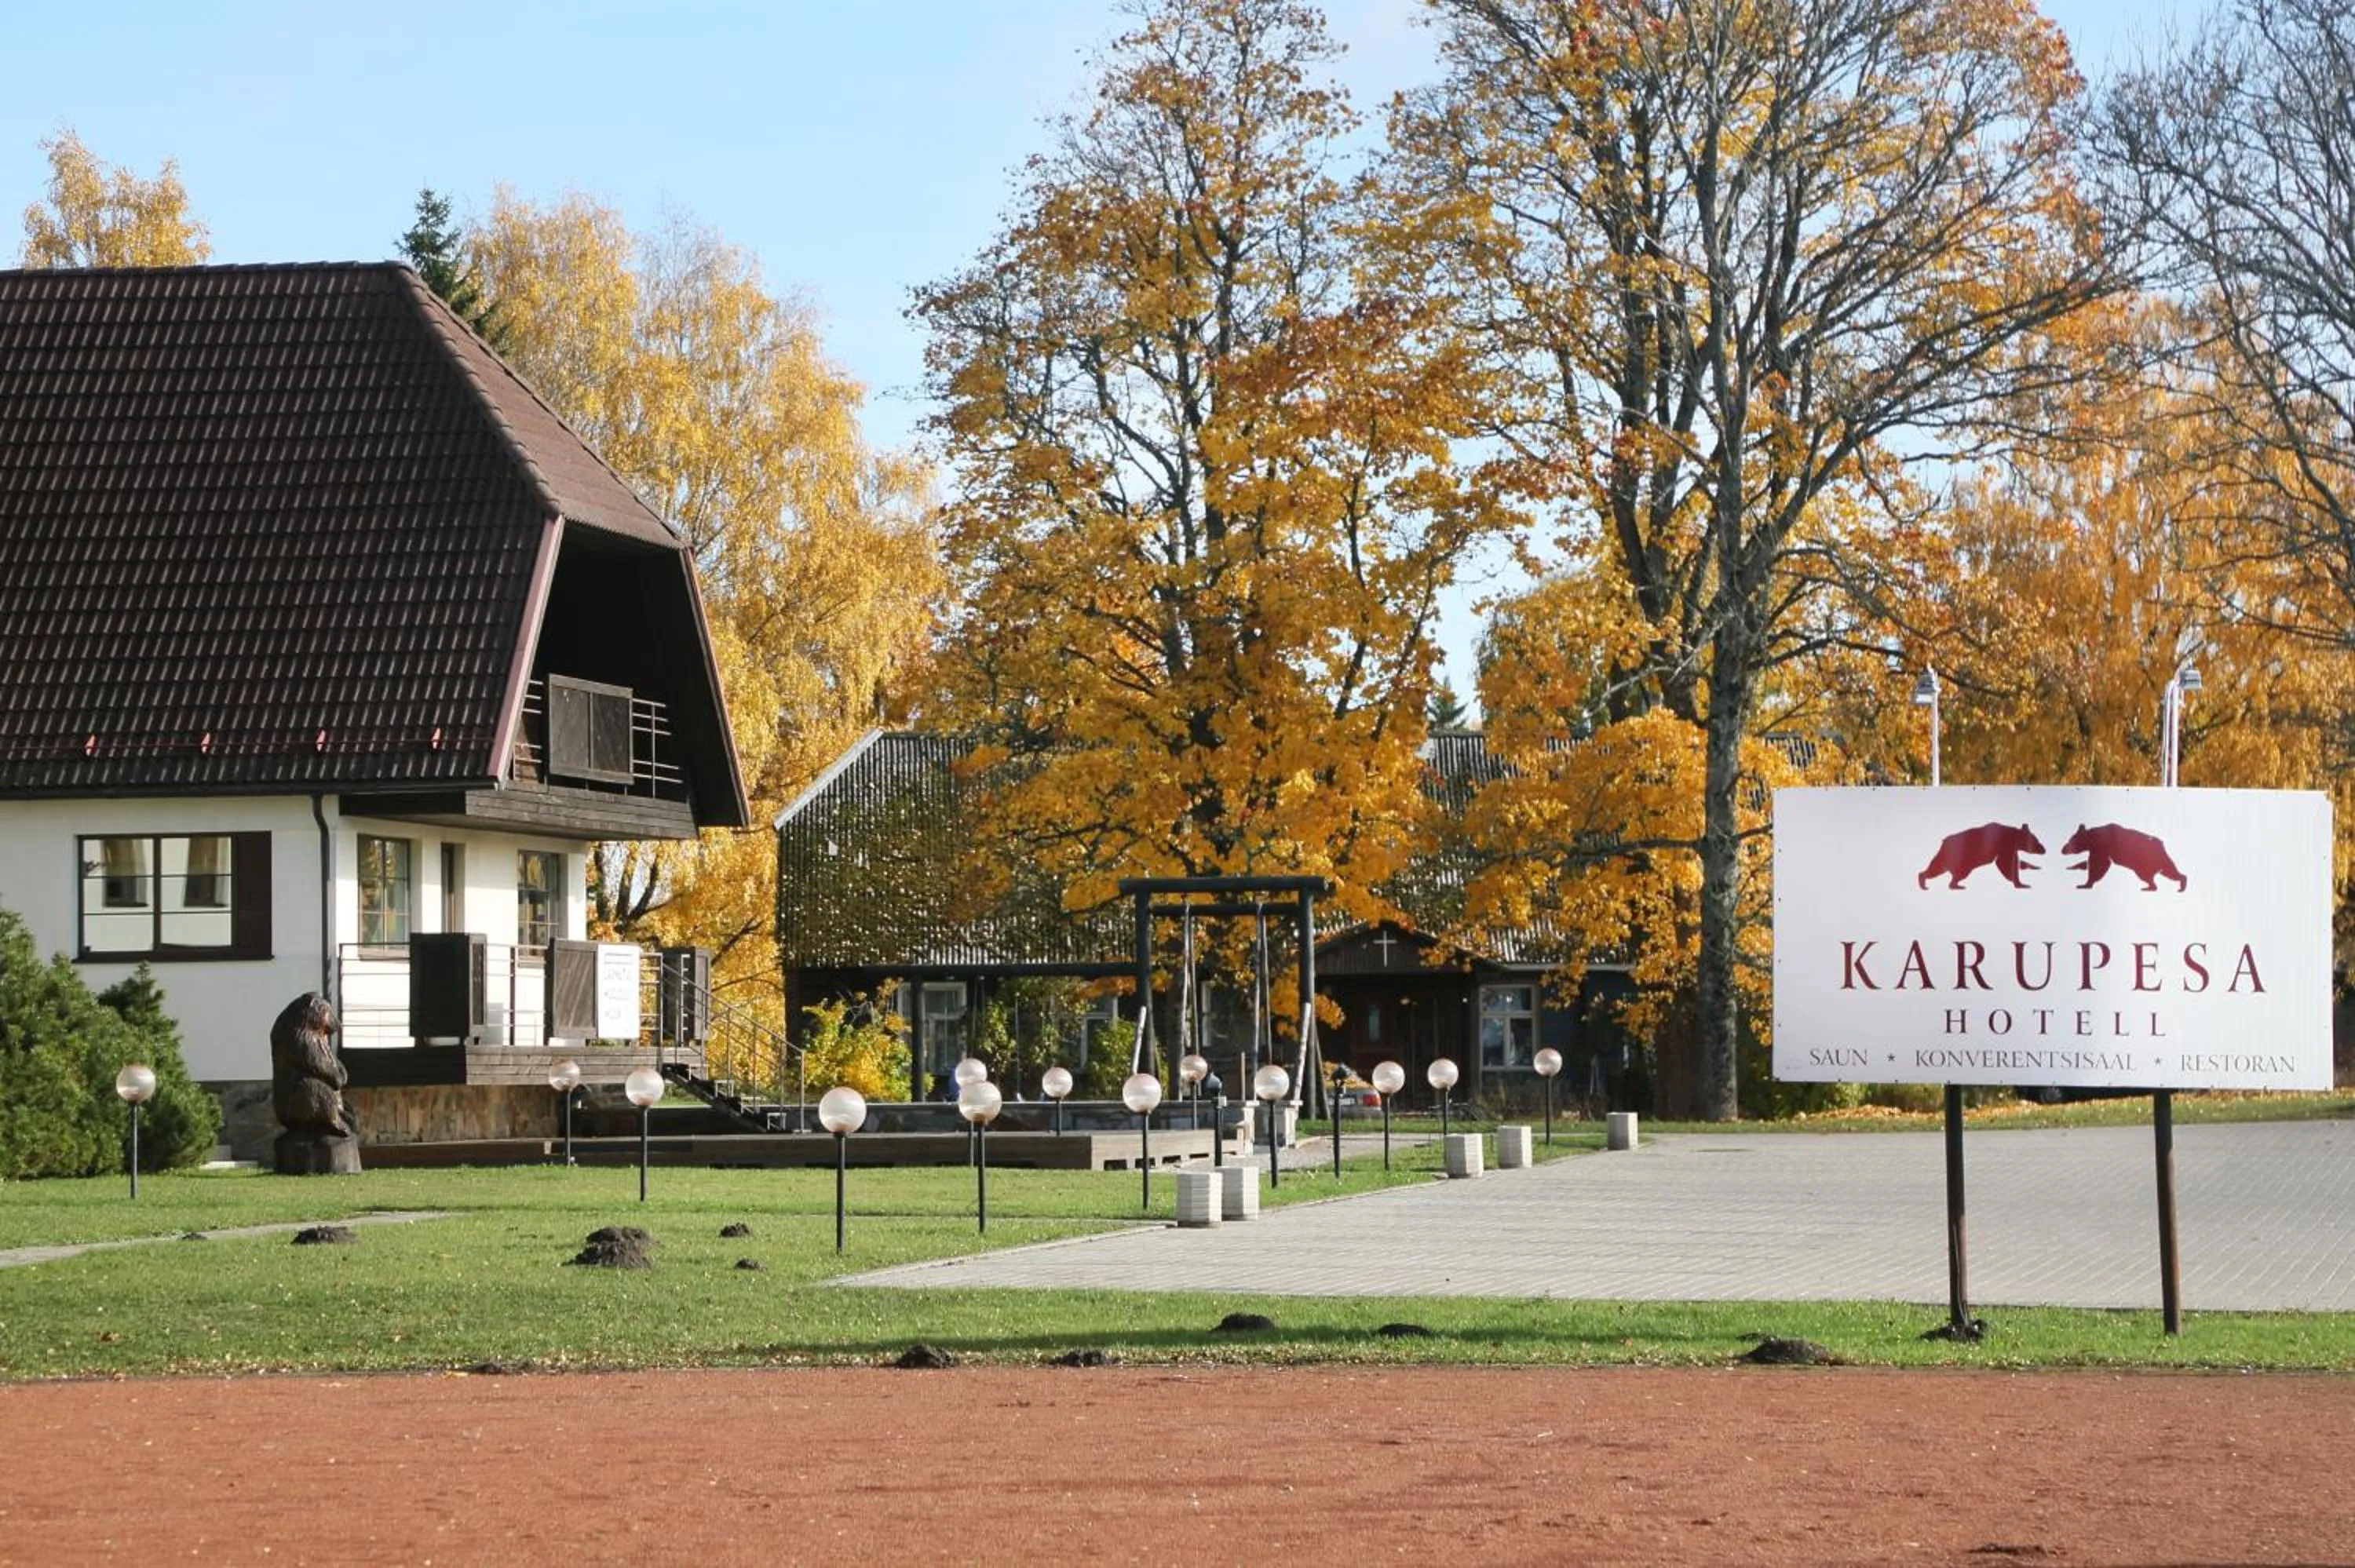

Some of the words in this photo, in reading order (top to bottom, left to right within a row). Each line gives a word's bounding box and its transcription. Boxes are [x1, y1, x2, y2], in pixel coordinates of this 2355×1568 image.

[1839, 939, 2267, 994] KARUPESA
[1944, 1009, 2167, 1037] HOTELL
[1809, 1048, 1868, 1067] SAUN
[1915, 1049, 2137, 1072] KONVERENTSISAAL
[2181, 1054, 2296, 1073] RESTORAN
